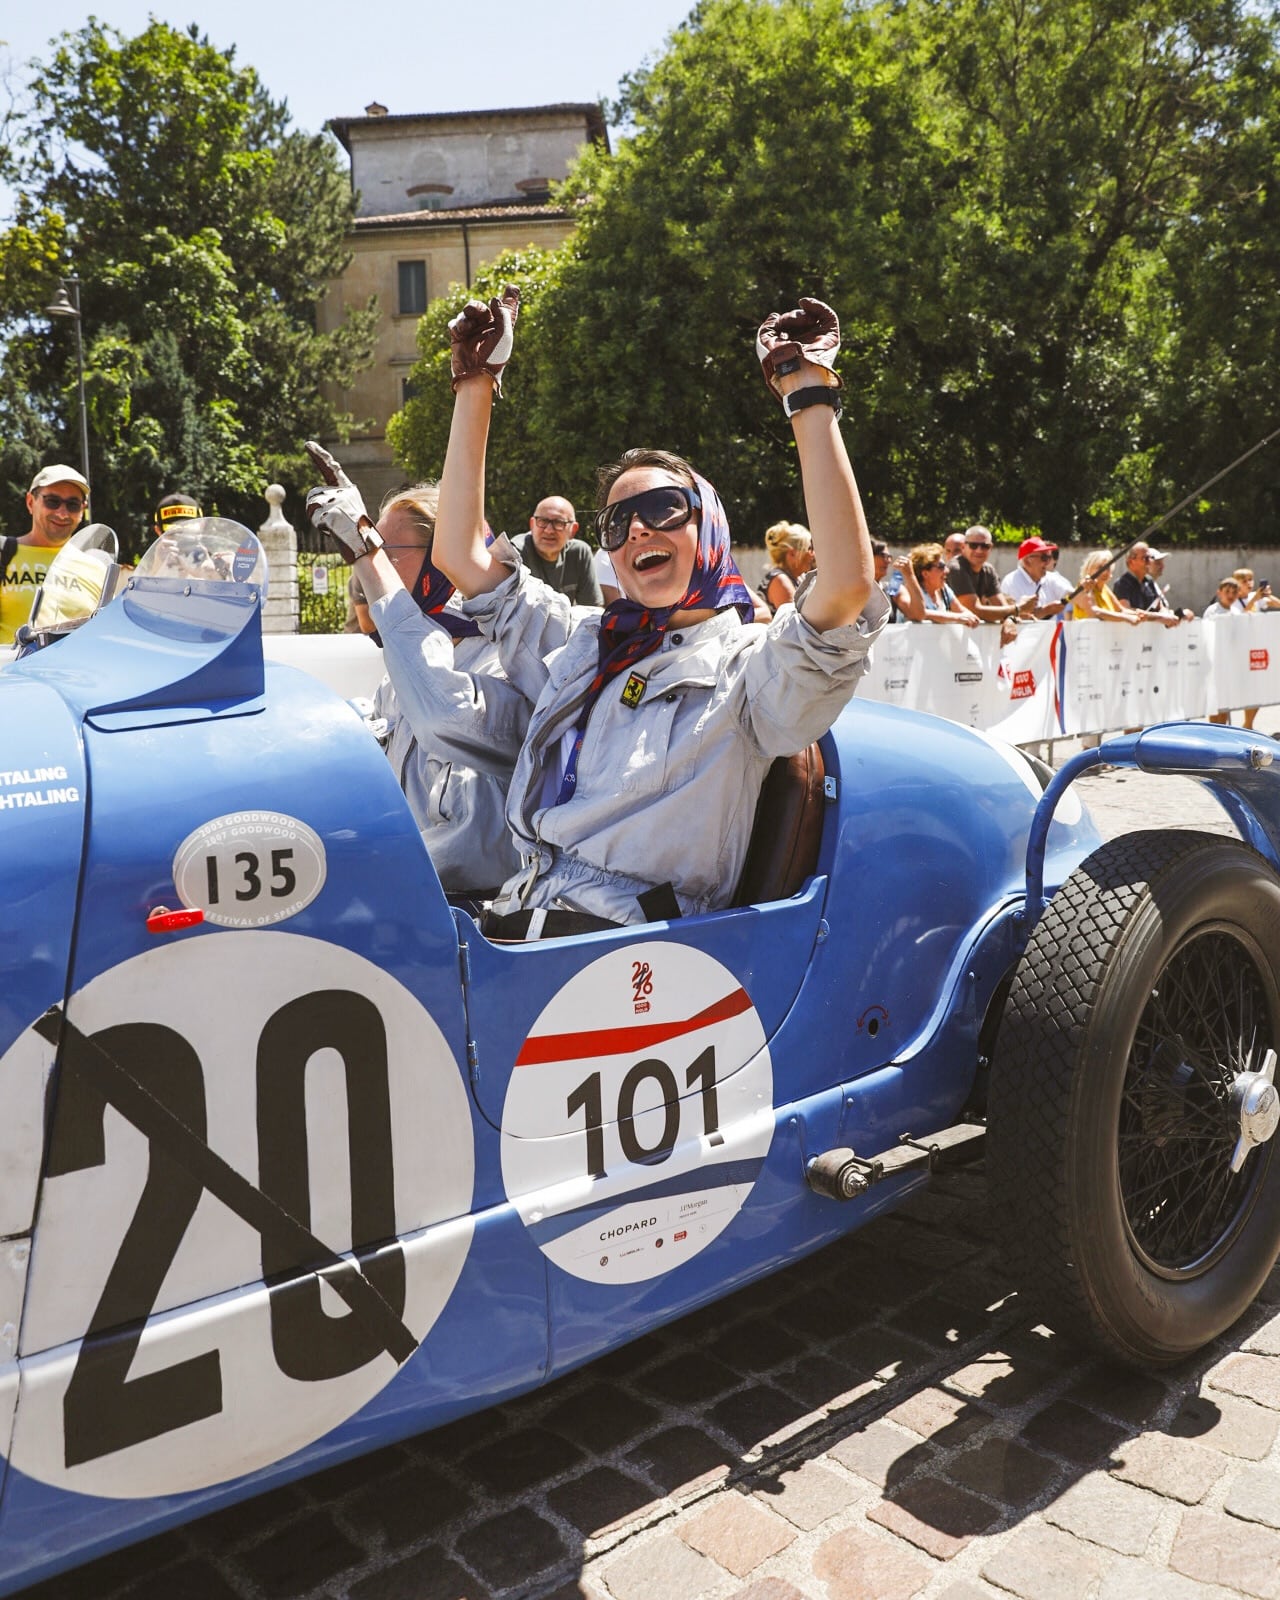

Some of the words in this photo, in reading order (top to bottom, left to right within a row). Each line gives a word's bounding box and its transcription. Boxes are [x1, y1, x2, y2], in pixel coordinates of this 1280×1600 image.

[0, 766, 68, 786] TALING
[225, 813, 296, 829] GOODWOOD
[231, 825, 296, 840] GOODWOOD
[206, 848, 296, 905] 135
[205, 910, 253, 926] FESTIVAL
[273, 901, 303, 921] SPEED
[567, 1044, 725, 1181] 101
[43, 988, 408, 1469] 20
[600, 1217, 657, 1241] CHOPARD
